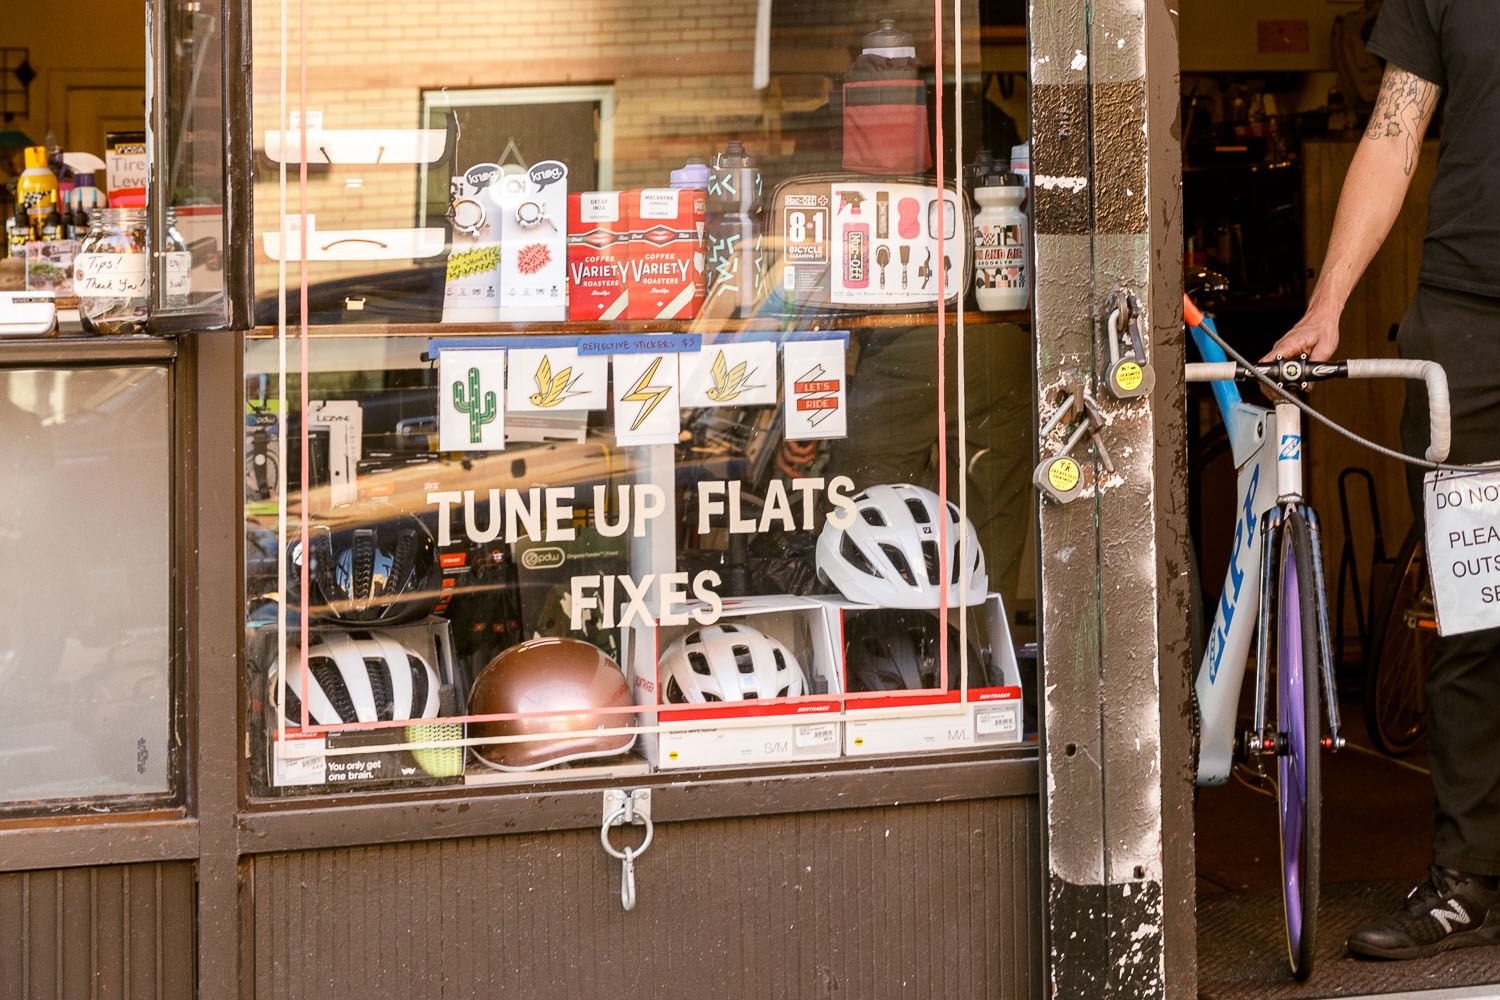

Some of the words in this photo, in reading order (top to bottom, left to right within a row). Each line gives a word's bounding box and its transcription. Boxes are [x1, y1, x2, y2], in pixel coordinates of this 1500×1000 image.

[111, 157, 145, 173] Tire
[585, 256, 615, 264] COFFEE
[645, 253, 675, 261] COFFEE
[985, 249, 1006, 260] AND
[88, 255, 123, 274] Tips!
[571, 261, 629, 286] VARIETY
[631, 259, 690, 284] VARIETY
[84, 277, 113, 291] Thank
[119, 278, 146, 293] You!
[583, 280, 619, 288] ROASTERS
[643, 278, 679, 286] ROASTERS
[583, 341, 629, 351] REFLECTIVE
[635, 340, 675, 349] STICKERS
[804, 381, 830, 391] LET'S
[806, 398, 830, 408] RIDE
[1437, 490, 1463, 510] DO
[426, 485, 576, 547] TUNE
[593, 484, 666, 538] UP
[697, 475, 857, 536] FLATS
[539, 551, 560, 563] pdw
[570, 569, 723, 631] FIXES
[328, 762, 345, 772] You
[346, 762, 365, 773] only
[366, 760, 381, 772] get
[328, 772, 346, 781] one
[348, 770, 374, 780] brain.
